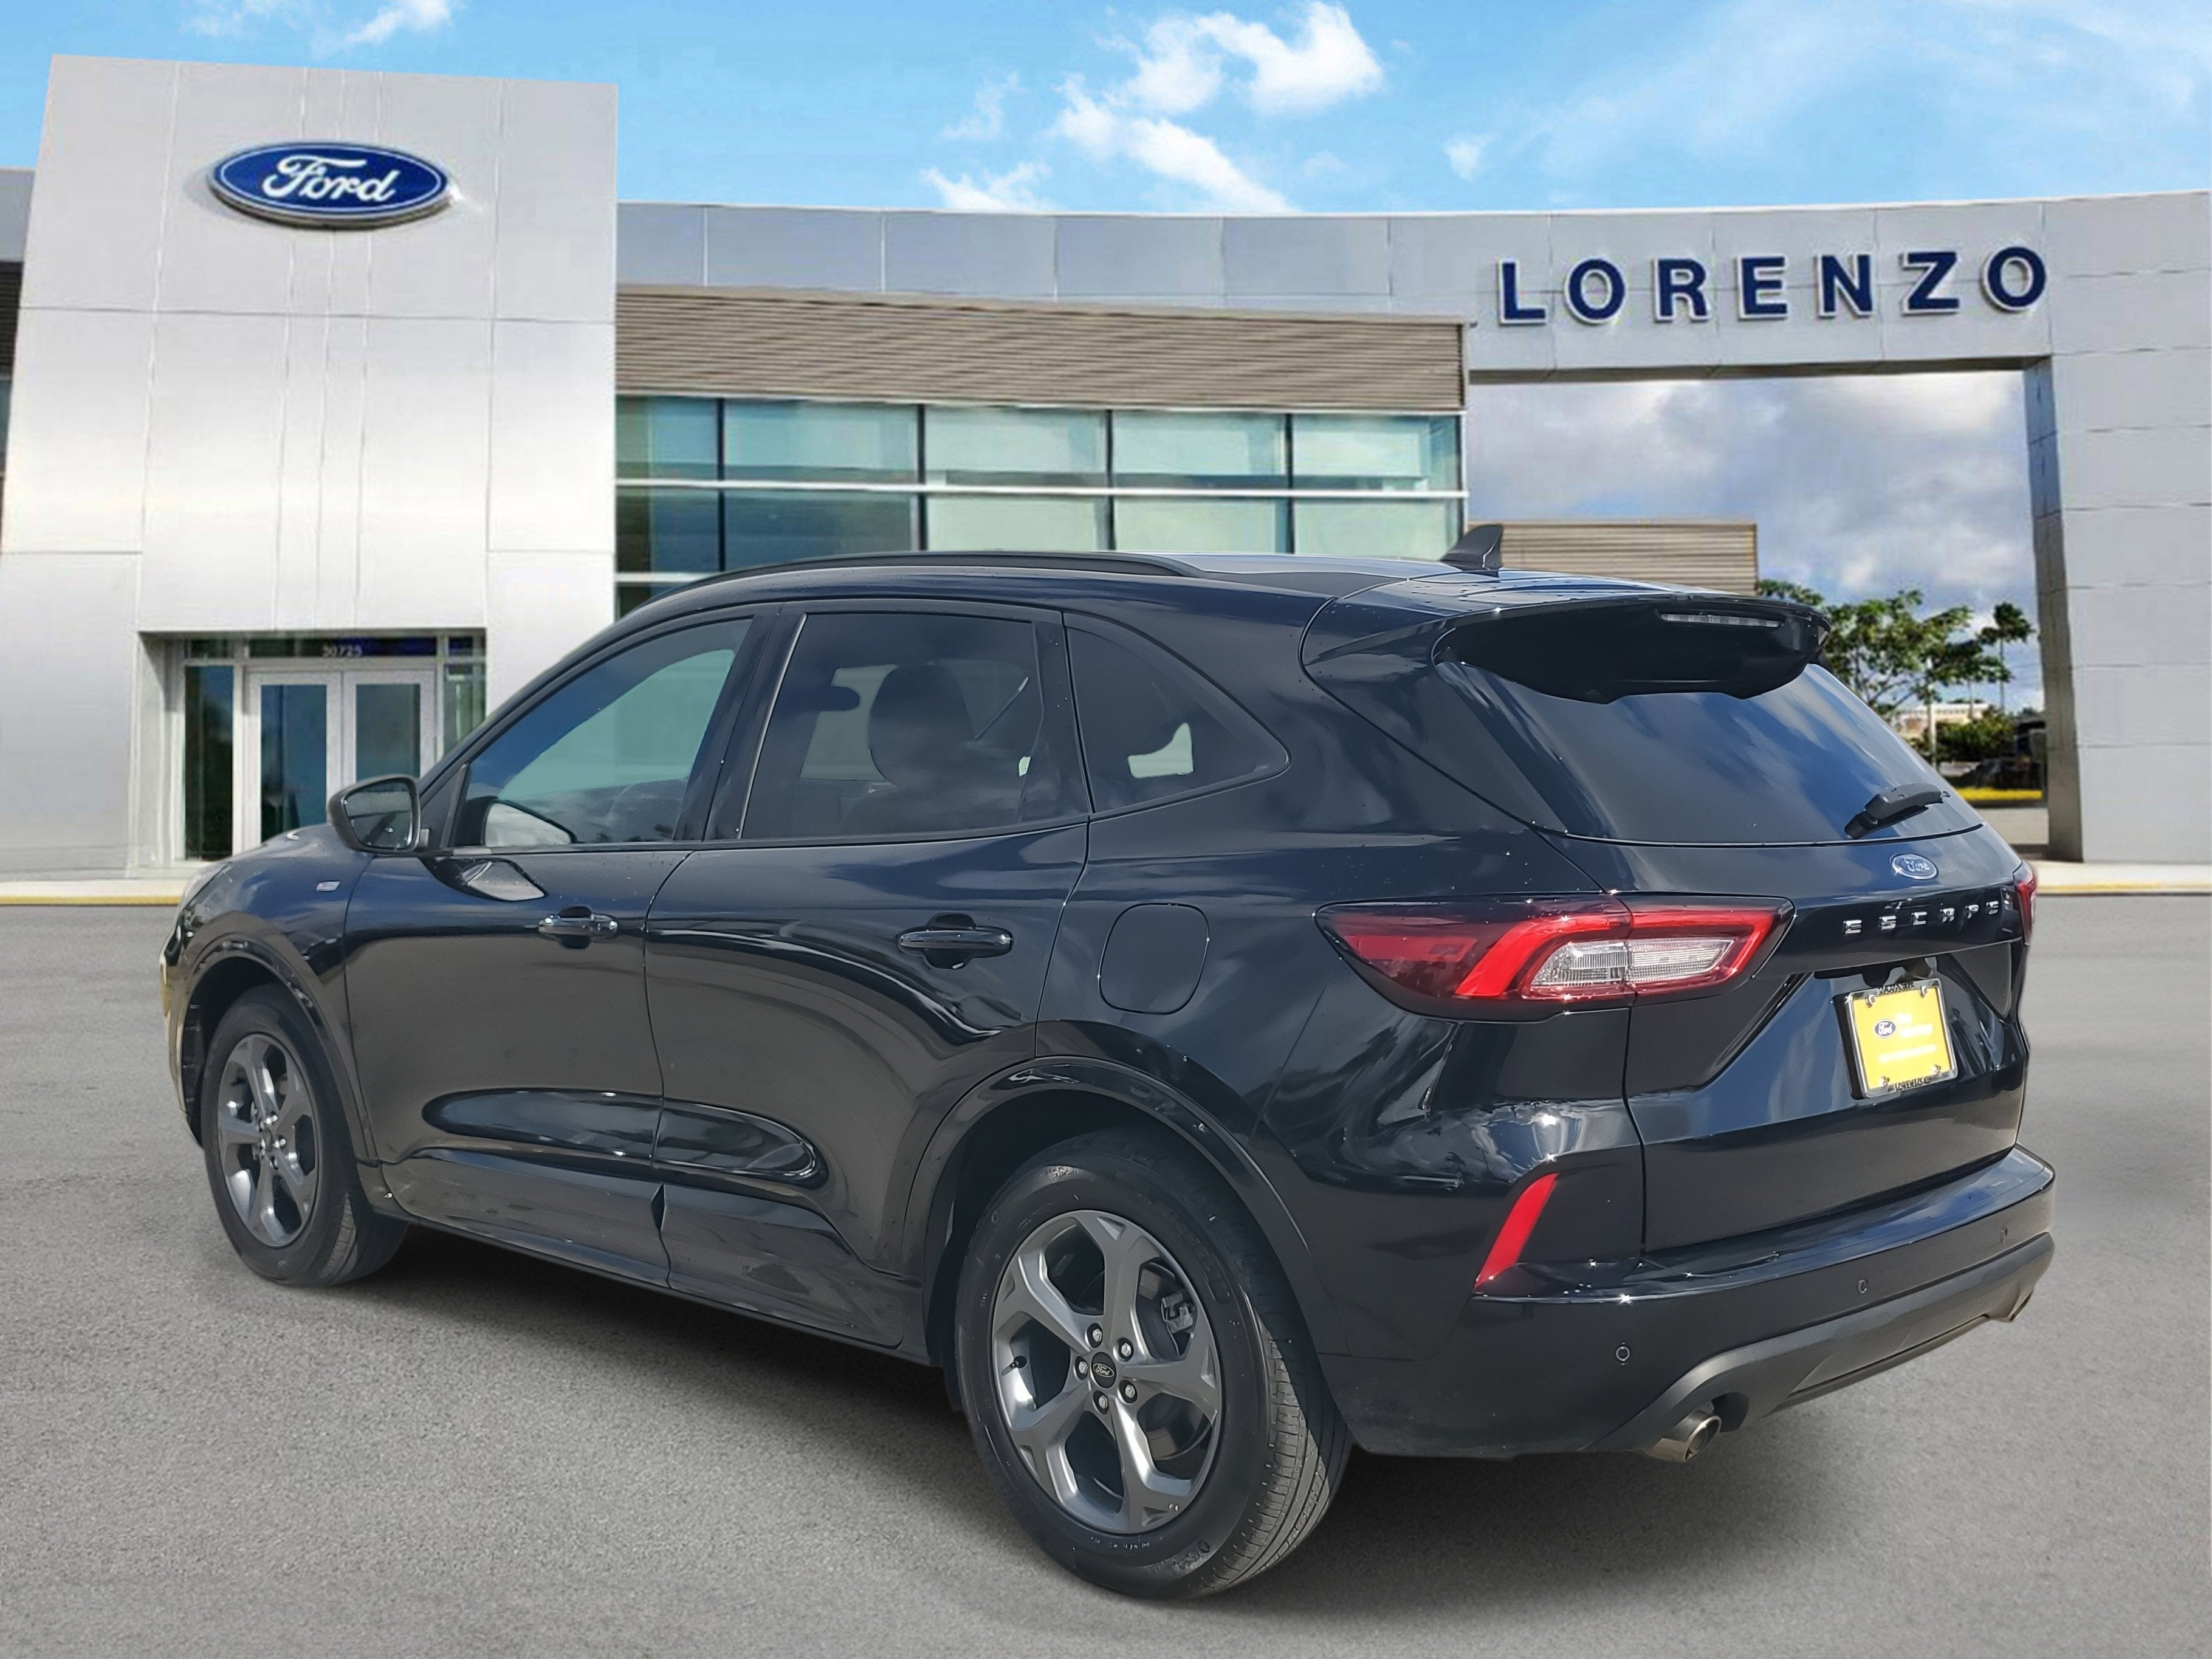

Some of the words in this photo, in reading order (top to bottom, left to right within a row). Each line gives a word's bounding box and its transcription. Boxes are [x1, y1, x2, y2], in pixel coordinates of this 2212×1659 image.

[262, 154, 400, 202] Ford
[1497, 246, 2047, 325] LORENZO
[1901, 857, 1930, 871] Ford
[1844, 901, 1999, 935] ESCAPE
[1096, 1365, 1110, 1375] Ford
